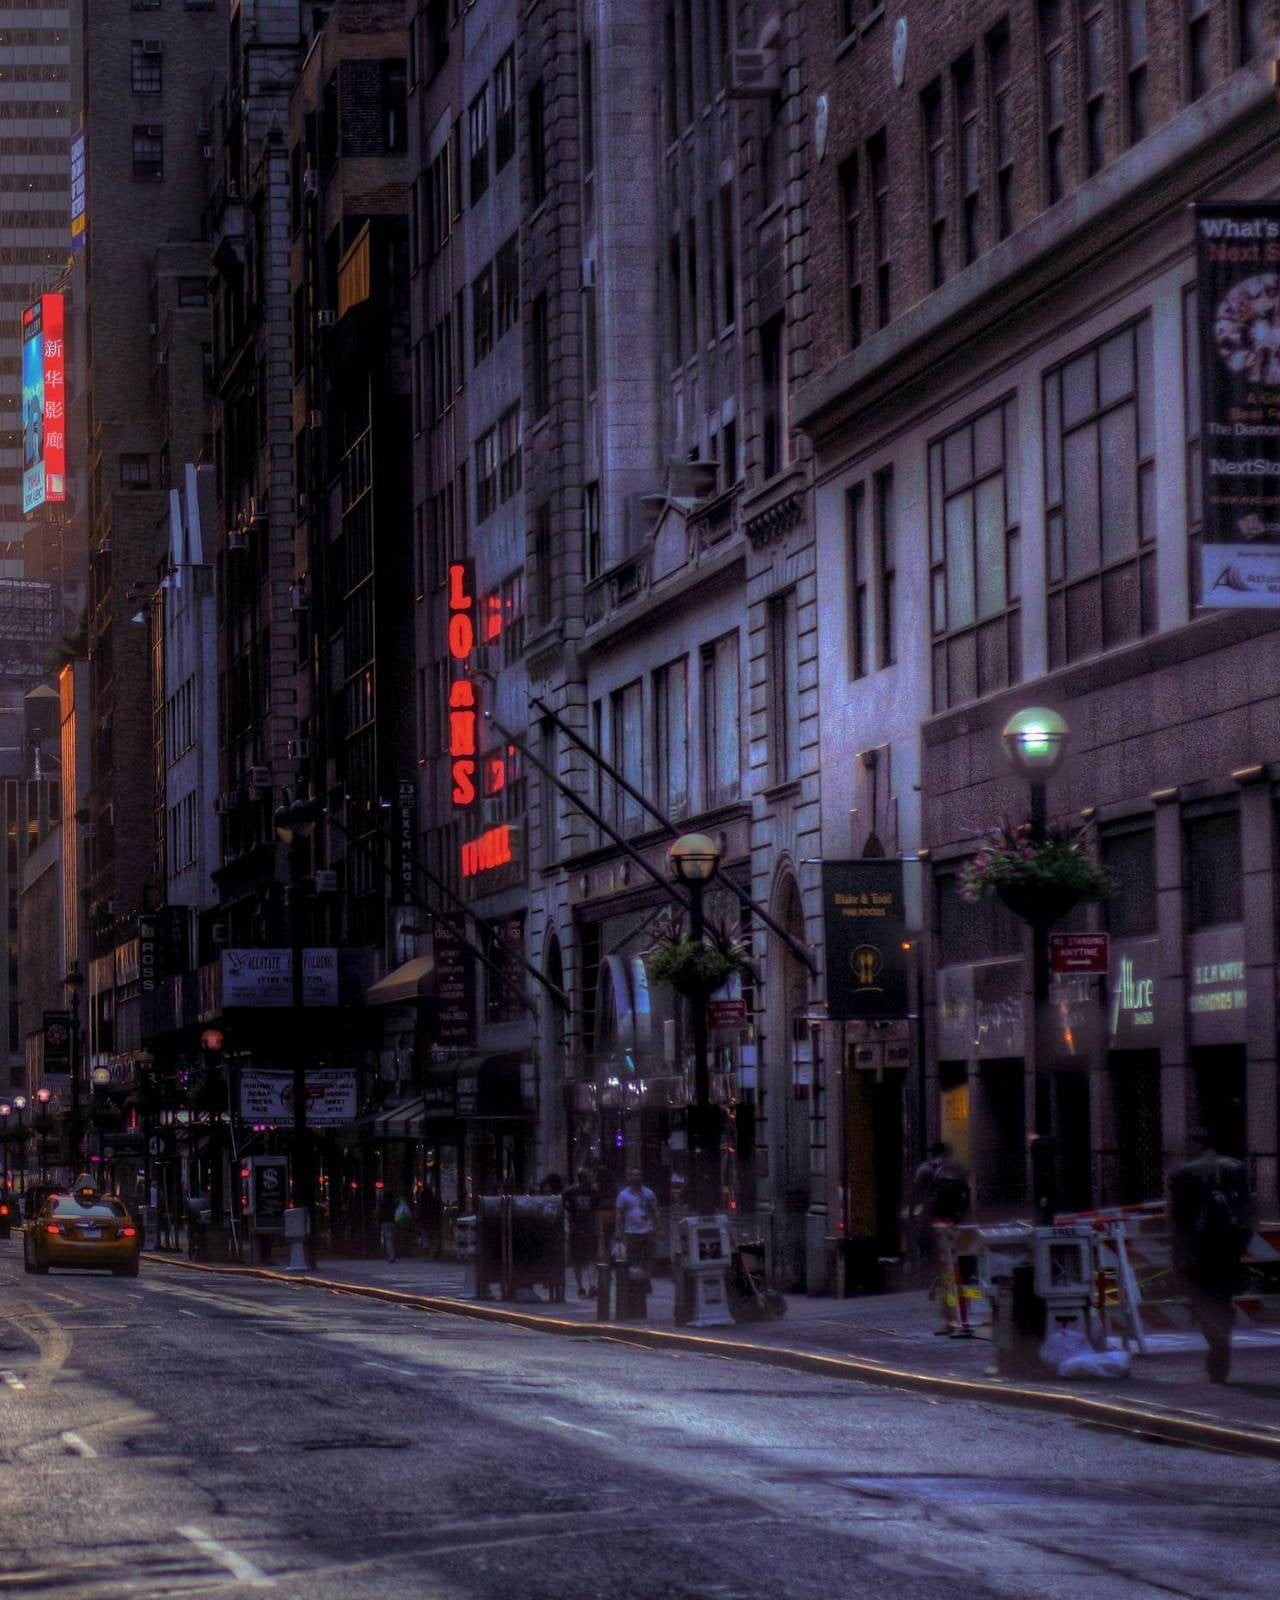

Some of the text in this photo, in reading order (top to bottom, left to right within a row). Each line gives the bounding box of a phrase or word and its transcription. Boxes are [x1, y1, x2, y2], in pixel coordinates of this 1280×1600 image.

[1200, 217, 1279, 239] What's
[1209, 422, 1233, 436] The
[1209, 459, 1280, 475] NextSto
